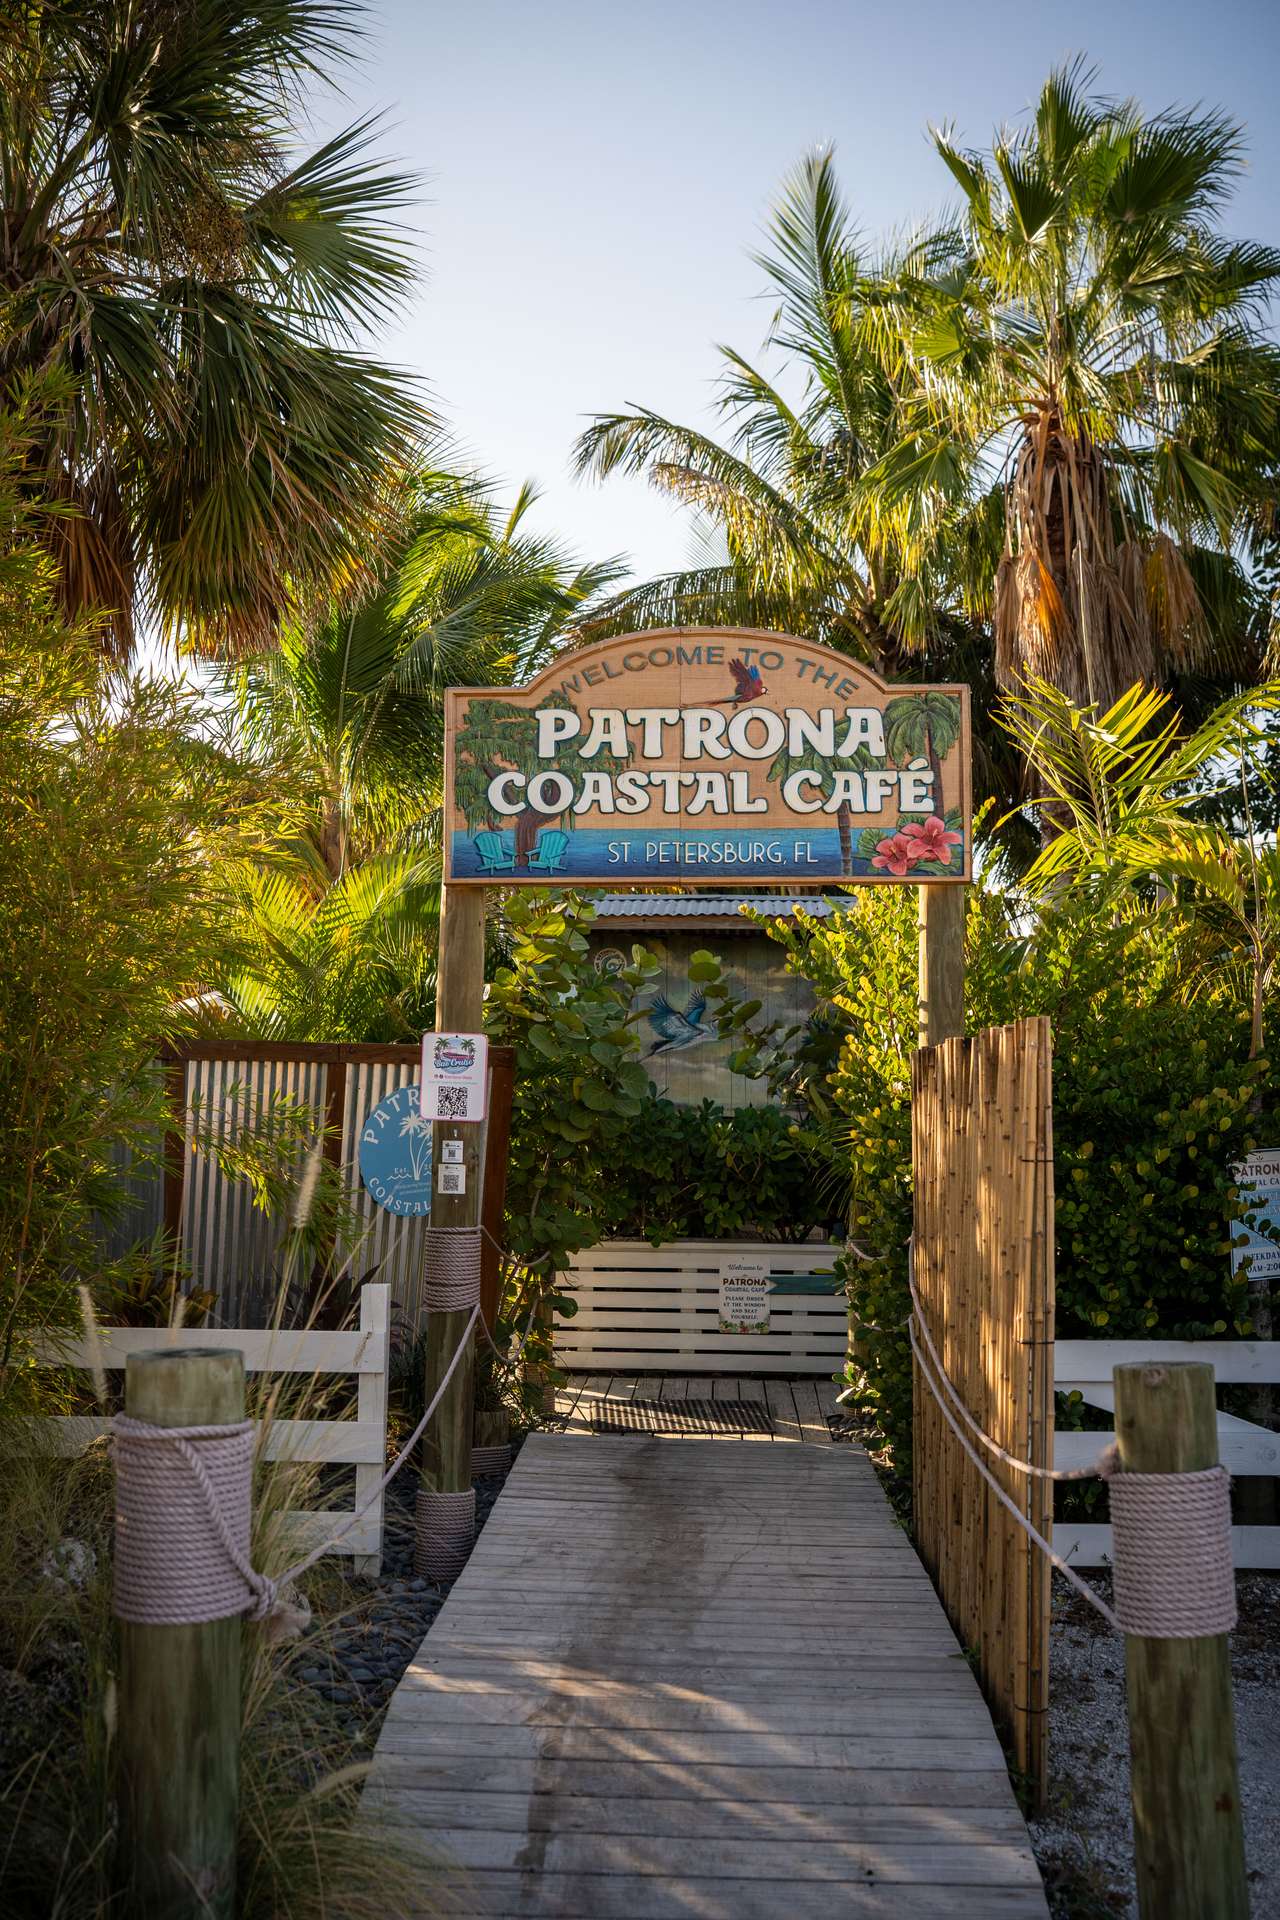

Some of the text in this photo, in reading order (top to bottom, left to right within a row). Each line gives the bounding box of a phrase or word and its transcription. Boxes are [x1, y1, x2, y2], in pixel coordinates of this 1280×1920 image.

[559, 646, 860, 701] WELCOME TO THE
[534, 707, 887, 760] PATRONA
[487, 756, 935, 815] COASTAL CAFÉ
[607, 841, 819, 865] ST. PETERSBURG, FL
[1231, 1163, 1280, 1177] ATRON
[369, 1177, 432, 1213] COASTAL
[722, 1278, 767, 1286] PATRONA
